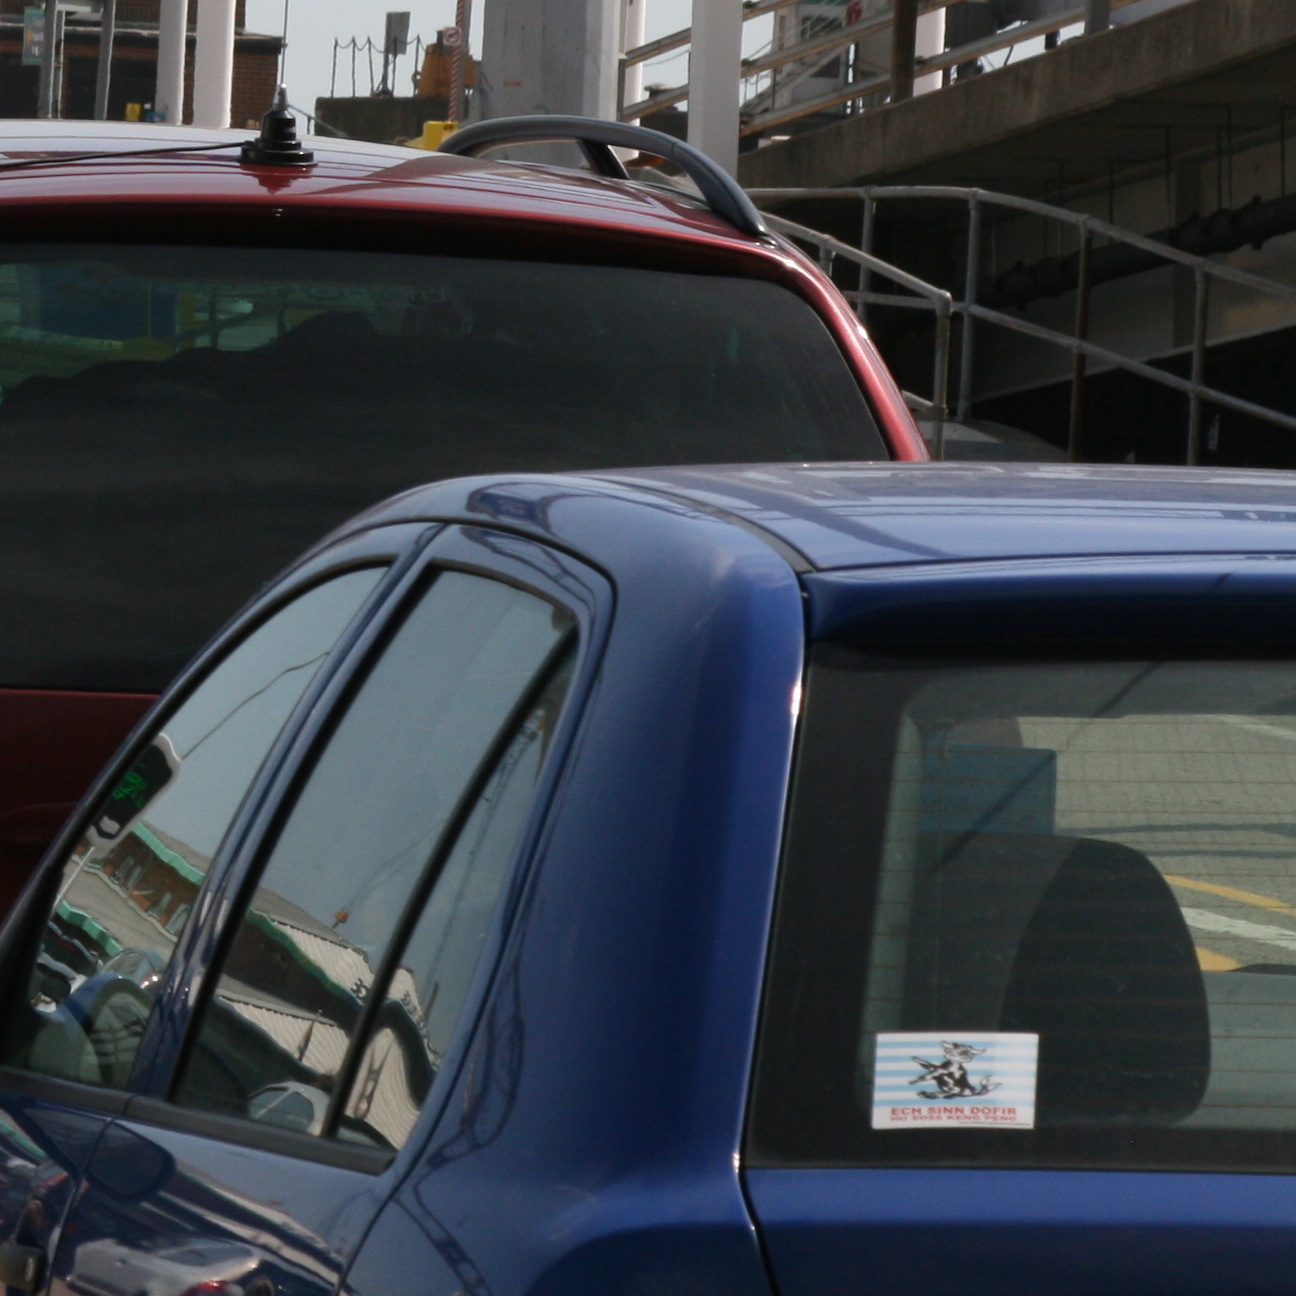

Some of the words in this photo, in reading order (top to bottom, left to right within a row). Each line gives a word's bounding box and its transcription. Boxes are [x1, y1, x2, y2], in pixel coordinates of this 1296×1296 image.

[891, 1107, 922, 1116] ECH
[928, 1107, 964, 1115] SINN
[971, 1107, 1017, 1116] DOFIR
